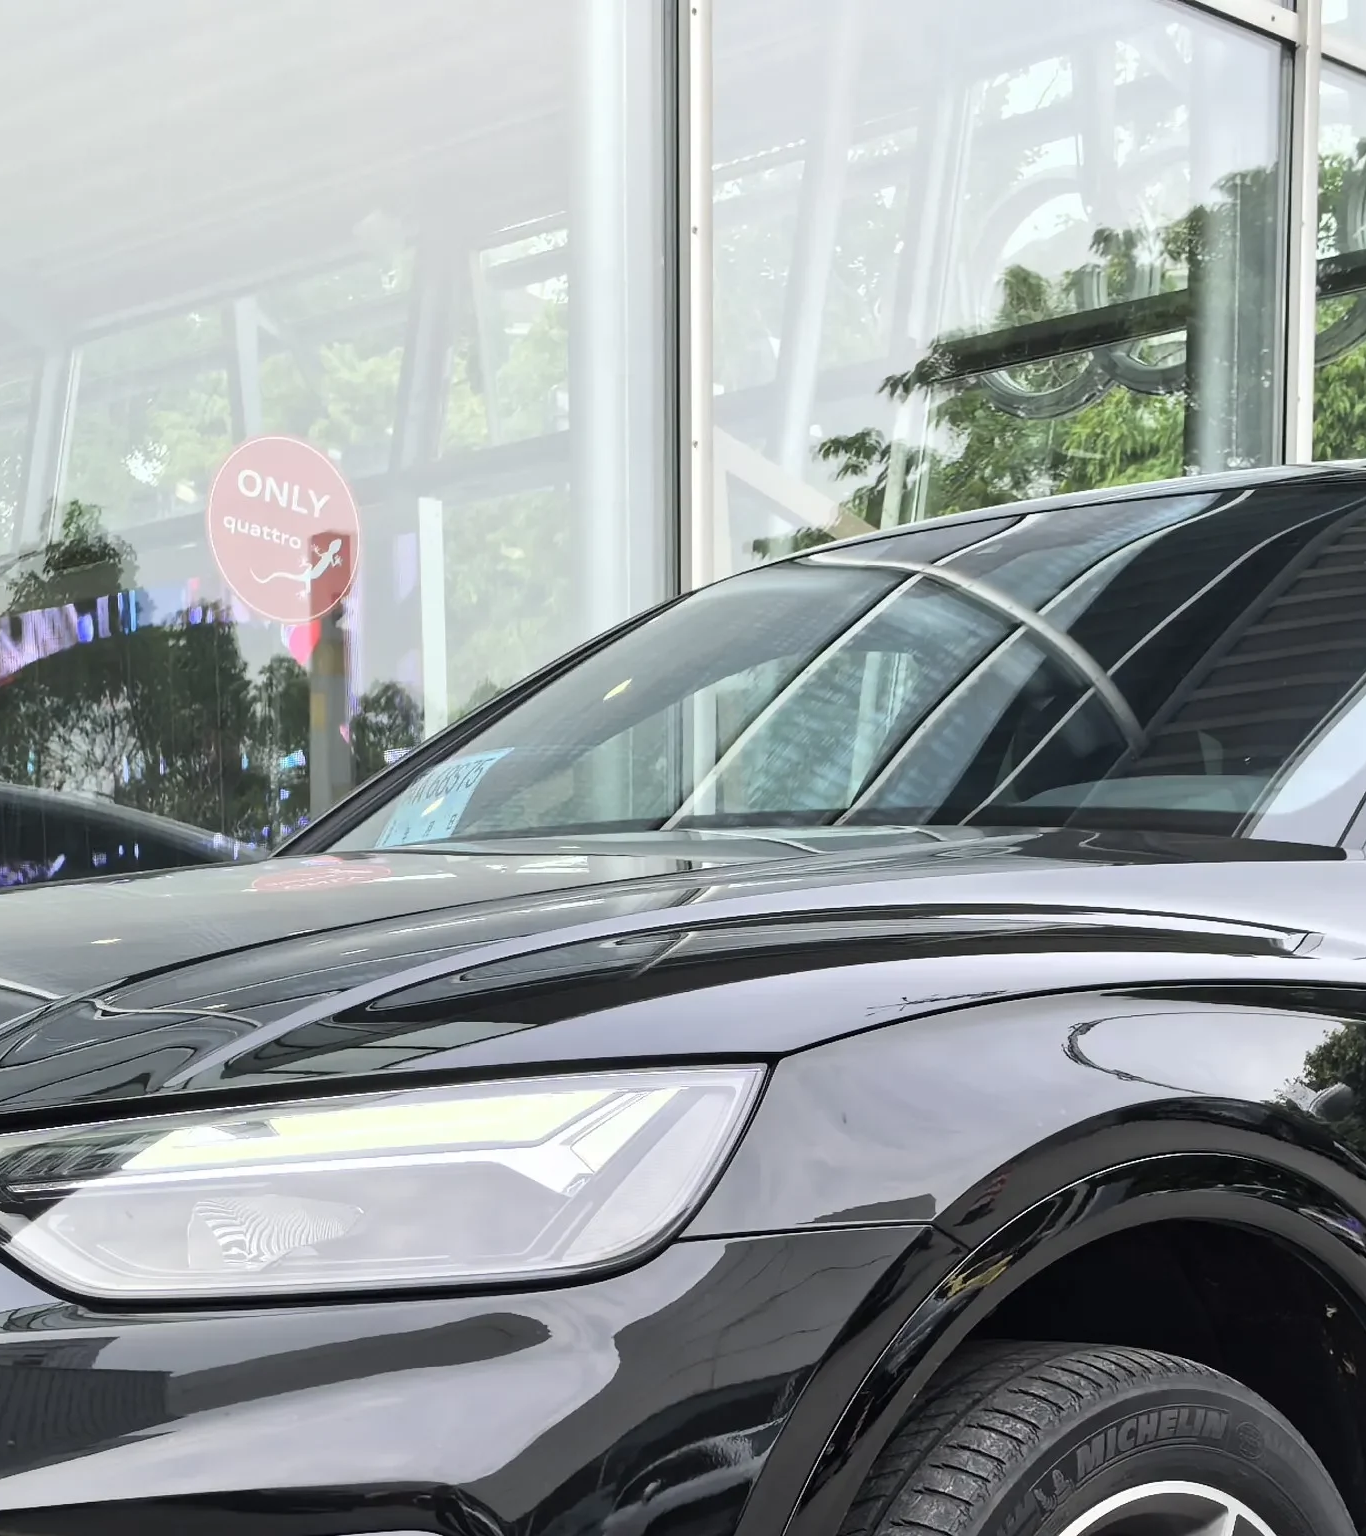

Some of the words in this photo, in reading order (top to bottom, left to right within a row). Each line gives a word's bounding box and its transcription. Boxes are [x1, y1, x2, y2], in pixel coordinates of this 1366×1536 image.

[237, 469, 330, 518] ONLY
[223, 515, 302, 549] quattro
[1076, 1408, 1229, 1479] MICHELIN
